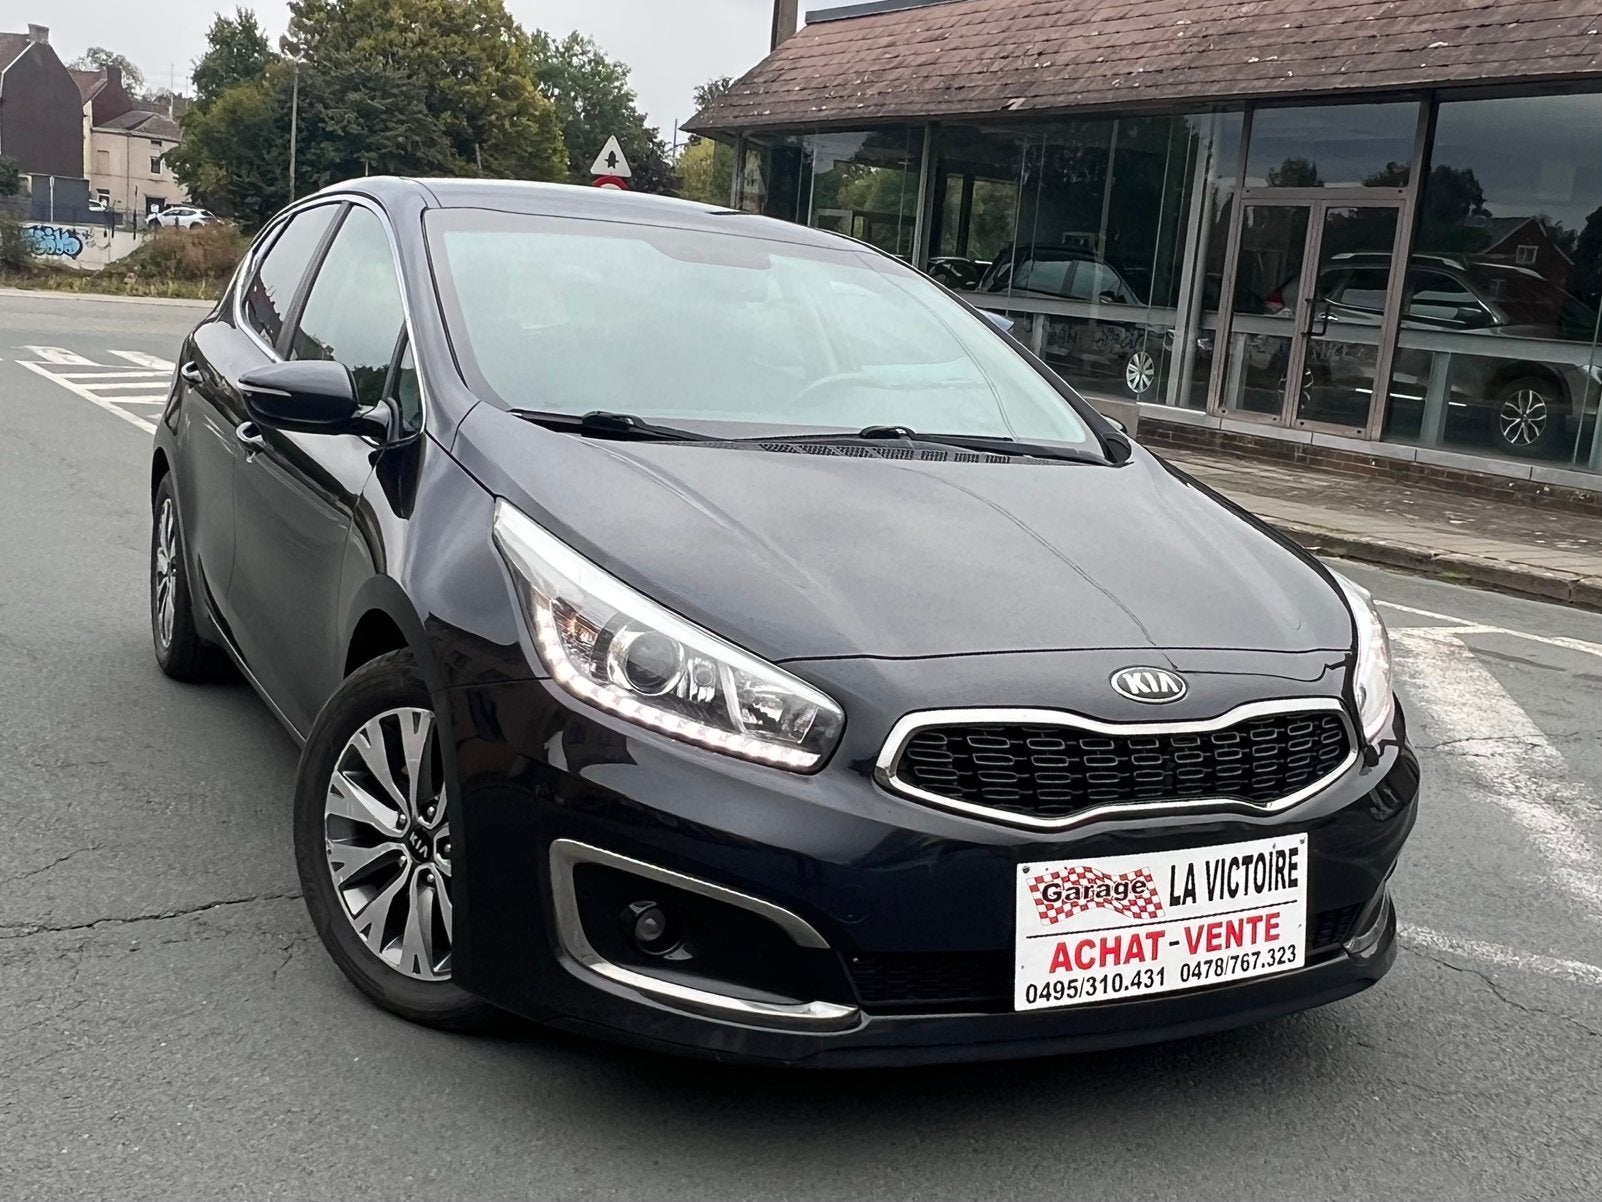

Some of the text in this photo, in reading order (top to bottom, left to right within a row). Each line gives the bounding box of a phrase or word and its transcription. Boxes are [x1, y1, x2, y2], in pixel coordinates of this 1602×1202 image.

[1122, 671, 1181, 695] KIA
[409, 831, 428, 858] KIA
[1041, 877, 1148, 903] Garage
[1169, 846, 1300, 907] LA VICTOIRE
[1025, 944, 1297, 1005] 0495/310.431 0478/767.323
